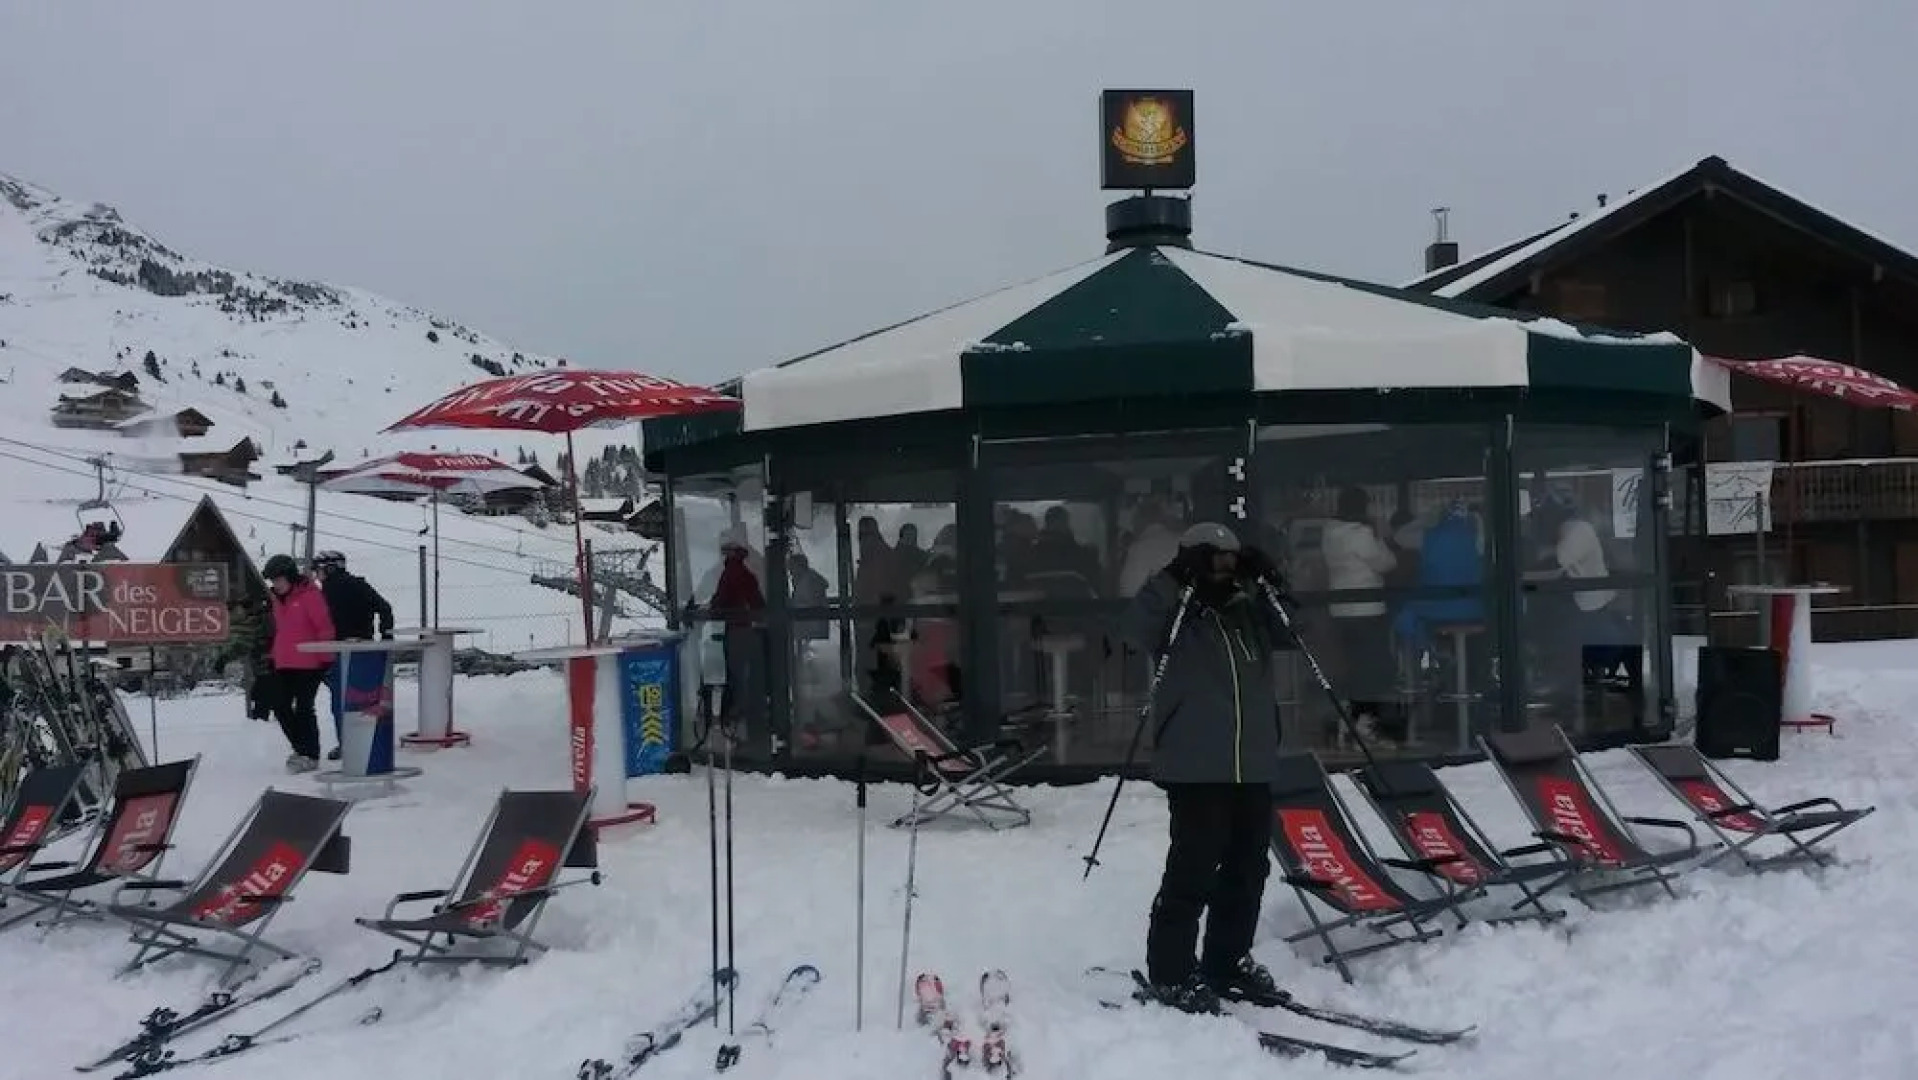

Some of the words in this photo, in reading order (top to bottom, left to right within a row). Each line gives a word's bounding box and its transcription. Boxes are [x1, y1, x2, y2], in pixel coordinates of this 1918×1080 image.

[5, 570, 108, 613] BAR
[113, 579, 156, 604] des
[107, 605, 221, 635] NEIGES
